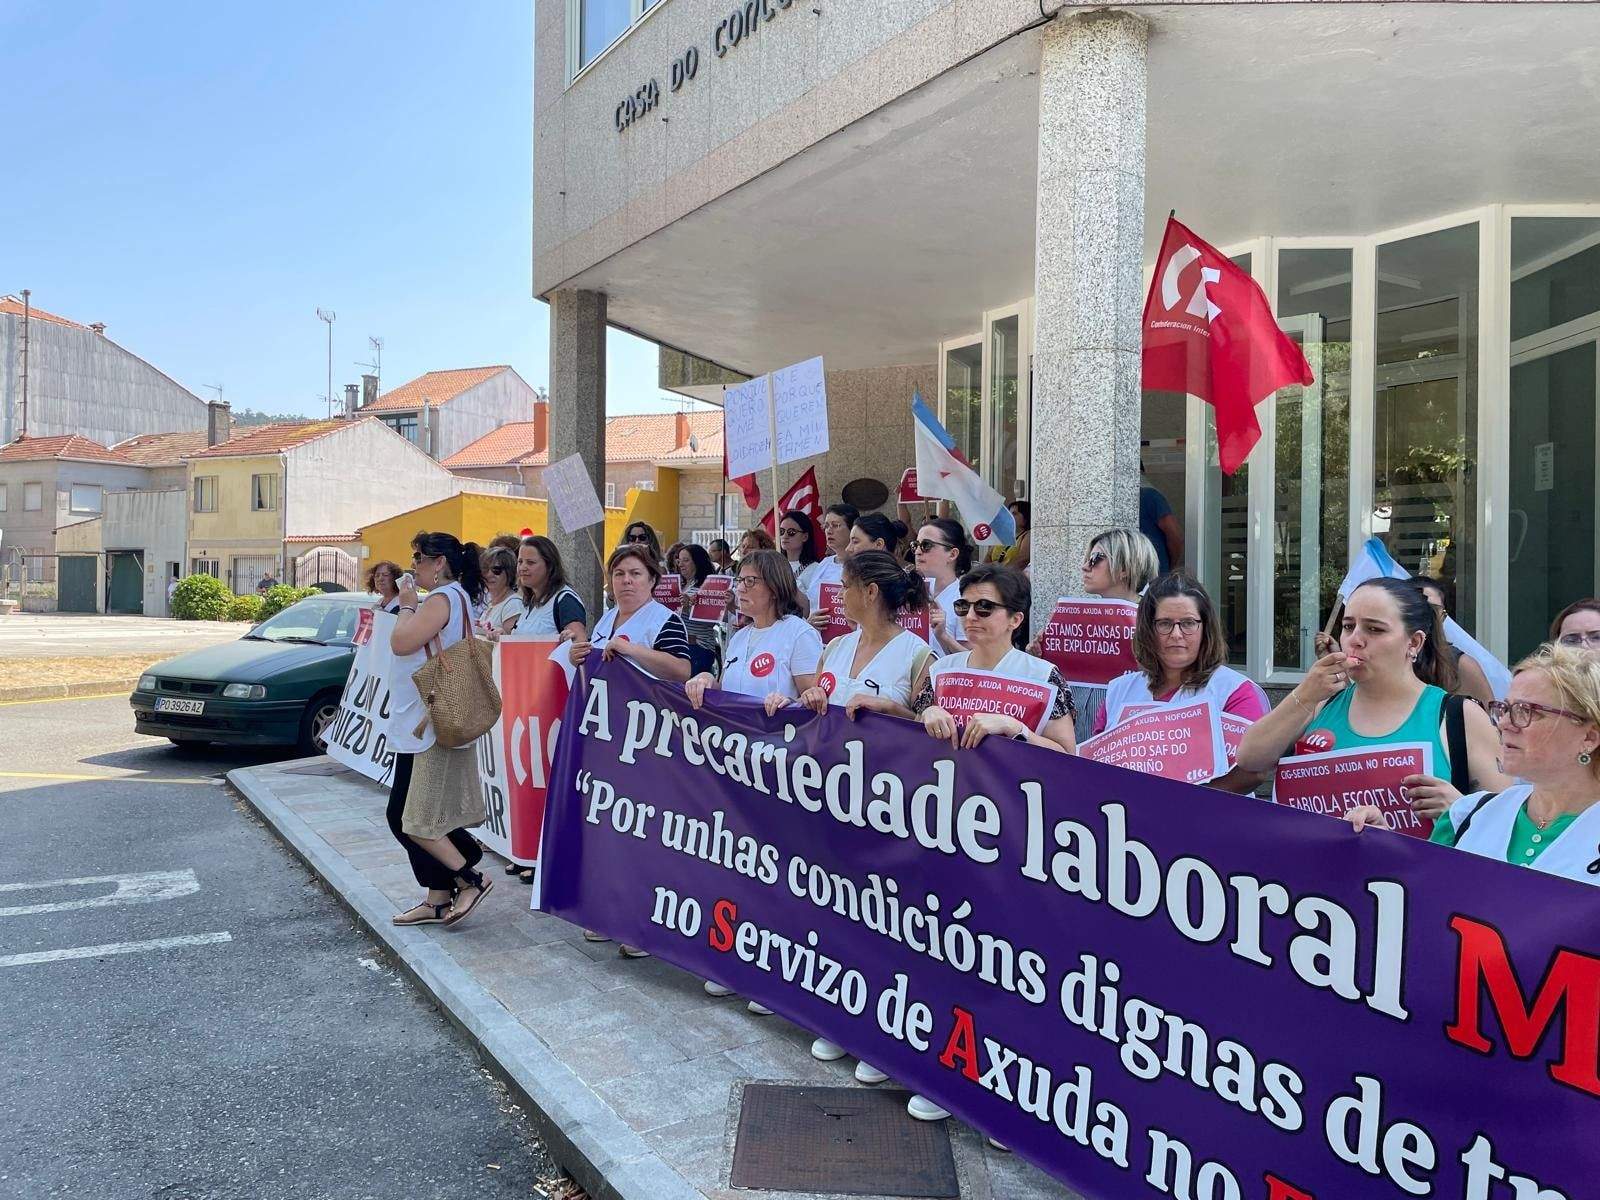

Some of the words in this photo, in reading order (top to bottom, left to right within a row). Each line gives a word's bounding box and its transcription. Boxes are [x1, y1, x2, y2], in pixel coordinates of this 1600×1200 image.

[615, 78, 660, 133] CASA
[671, 46, 698, 93] DO
[713, 0, 793, 58] CONC
[1045, 622, 1084, 638] ESTAMOS
[1086, 624, 1121, 640] CANSAS
[1123, 626, 1136, 640] DE
[1045, 638, 1062, 651] SER
[1063, 639, 1121, 656] EXPLOTADAS
[978, 680, 1002, 691] AXUDA
[169, 700, 191, 712] 3926
[191, 702, 202, 713] AZ
[1003, 702, 1027, 719] CON
[1134, 716, 1160, 728] AXUDA
[1092, 729, 1165, 758] SOLIDARIEDADE
[1168, 727, 1191, 741] CON
[1306, 734, 1328, 748] CIG
[1130, 745, 1147, 758] DO
[1149, 745, 1169, 757] SAF
[1171, 743, 1188, 755] DO
[1186, 768, 1210, 782] CIG
[1280, 765, 1330, 780] CIG-SERVIZOS
[1334, 760, 1363, 774] AXUDA
[1366, 759, 1379, 769] NO
[1382, 755, 1416, 768] FOGAR
[1288, 793, 1342, 814] FABIOLA
[1342, 785, 1400, 811] ESCOITA
[1383, 808, 1423, 830] OITA
[577, 677, 614, 742] A
[618, 700, 1001, 864] precariedade
[1019, 781, 1410, 1021] laboral
[660, 811, 780, 885] unhas
[788, 856, 1047, 1004] condicións
[1060, 954, 1303, 1131] dignas
[1325, 1076, 1437, 1196] de
[650, 886, 702, 938] no
[709, 900, 867, 1016] Servizo
[876, 973, 934, 1052] de
[939, 1006, 1130, 1169] Axuda
[1145, 1129, 1241, 1200] no
